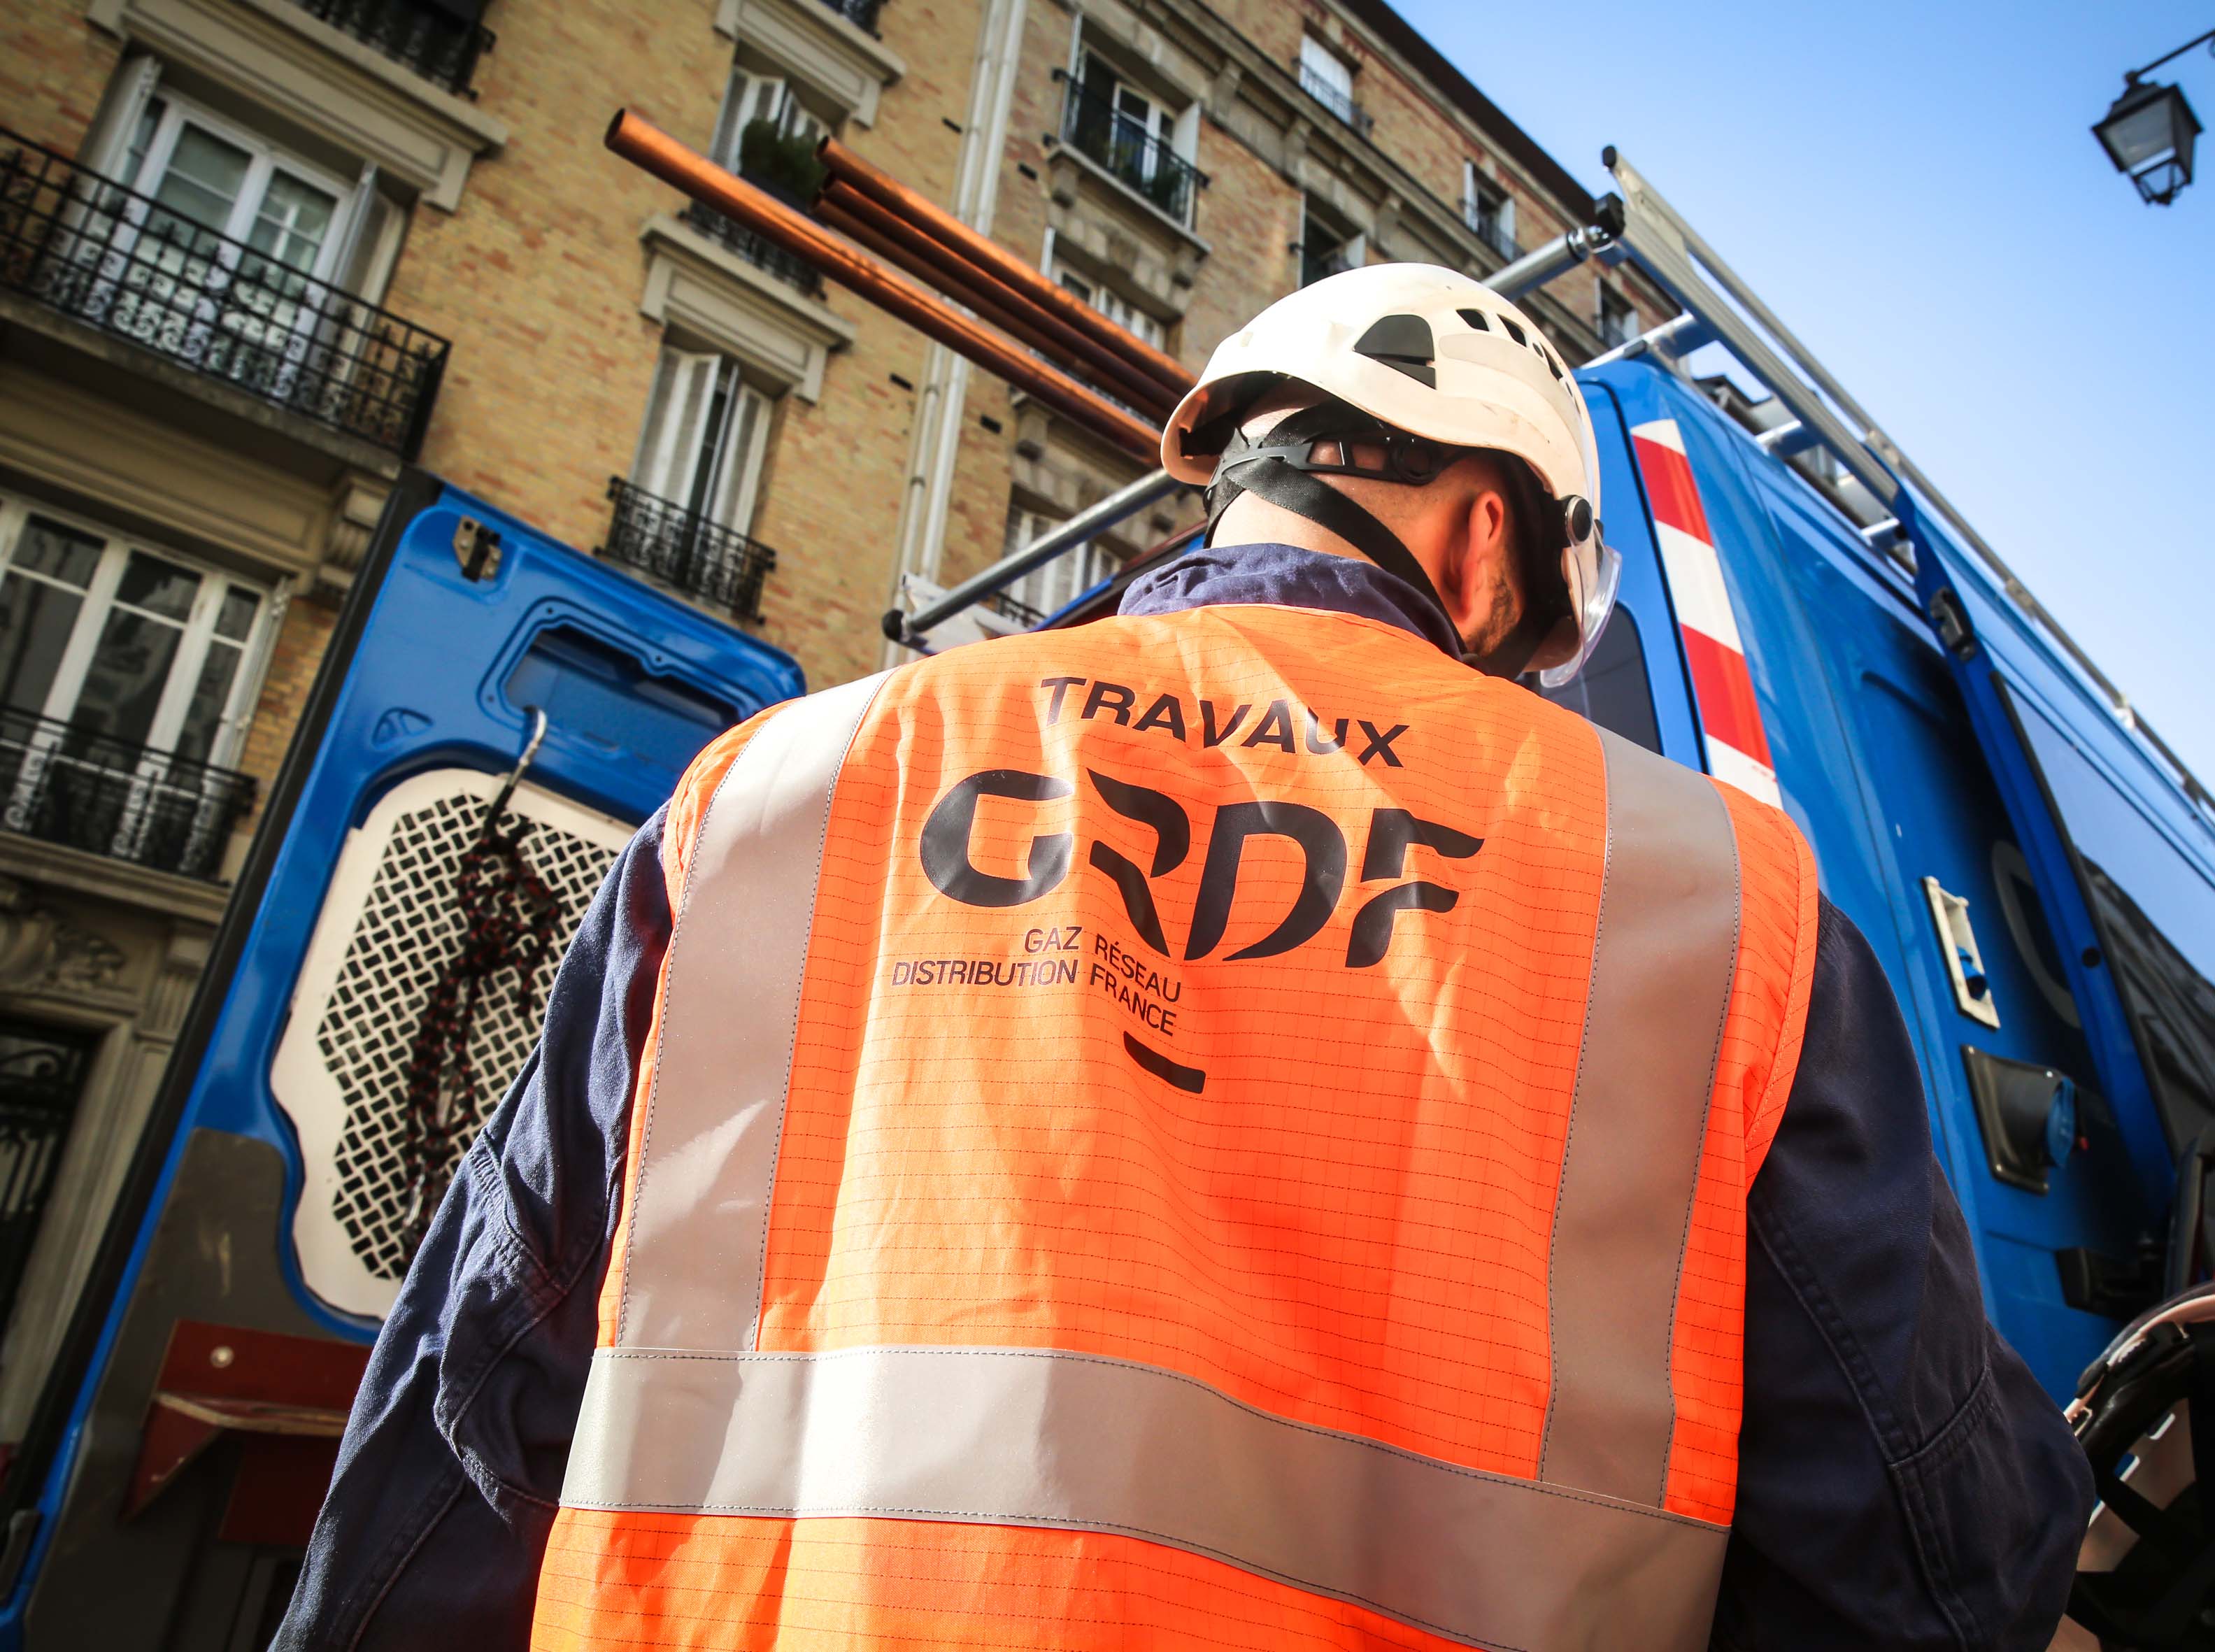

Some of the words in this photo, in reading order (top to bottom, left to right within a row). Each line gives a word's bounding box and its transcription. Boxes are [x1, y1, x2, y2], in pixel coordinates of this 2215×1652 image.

[1040, 676, 1409, 767] TRAVAUX
[920, 768, 1484, 968] GRDF
[892, 960, 1077, 986] DISTRIBUTION
[1090, 964, 1176, 1037] FRANCE
[1025, 927, 1082, 953] GAZ
[1095, 934, 1181, 1002] RÉSEAU
